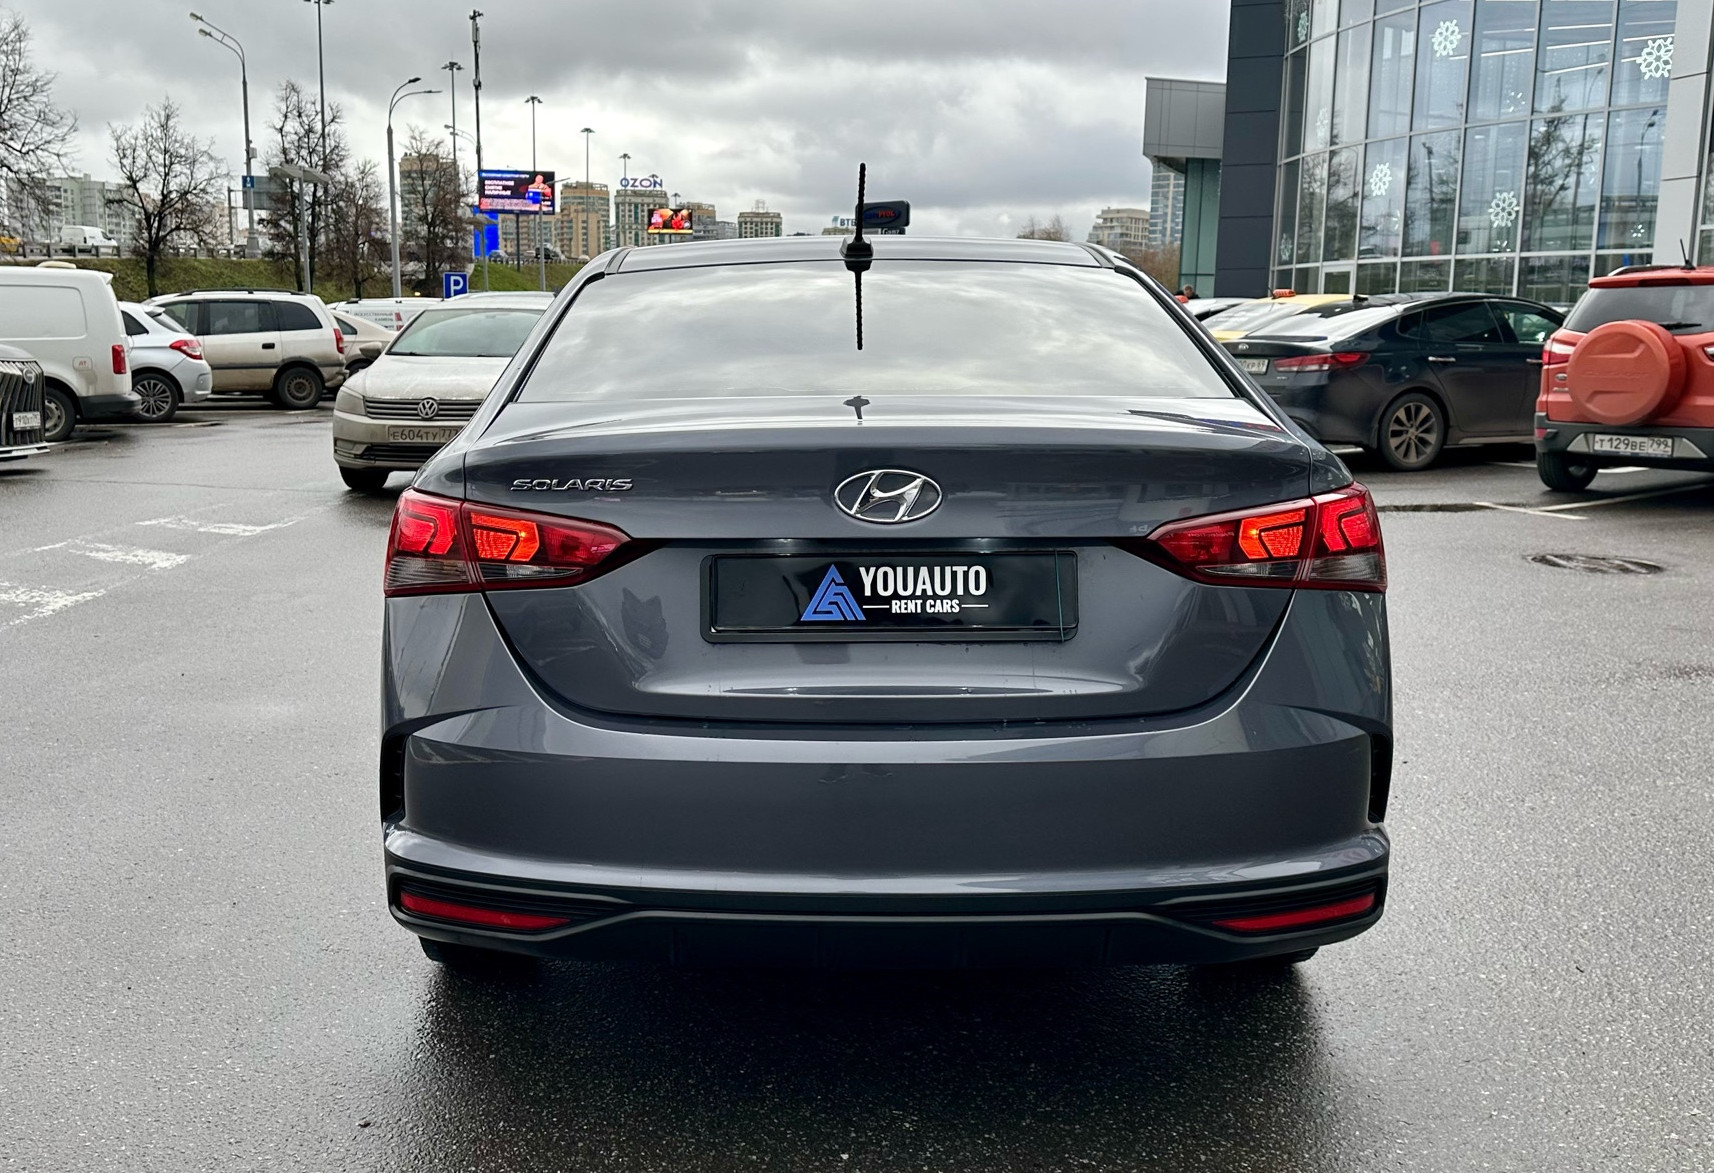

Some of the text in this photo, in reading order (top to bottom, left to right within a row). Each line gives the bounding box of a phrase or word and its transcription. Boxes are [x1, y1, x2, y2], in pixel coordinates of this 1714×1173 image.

[620, 177, 663, 189] OZON
[450, 275, 464, 297] P
[392, 429, 438, 441] Е604ТУ
[1599, 437, 1668, 451] Т129ВЕ 799
[510, 478, 633, 491] SOLARIS
[859, 565, 987, 597] YOUAUTO
[891, 598, 960, 614] RENT CARS
